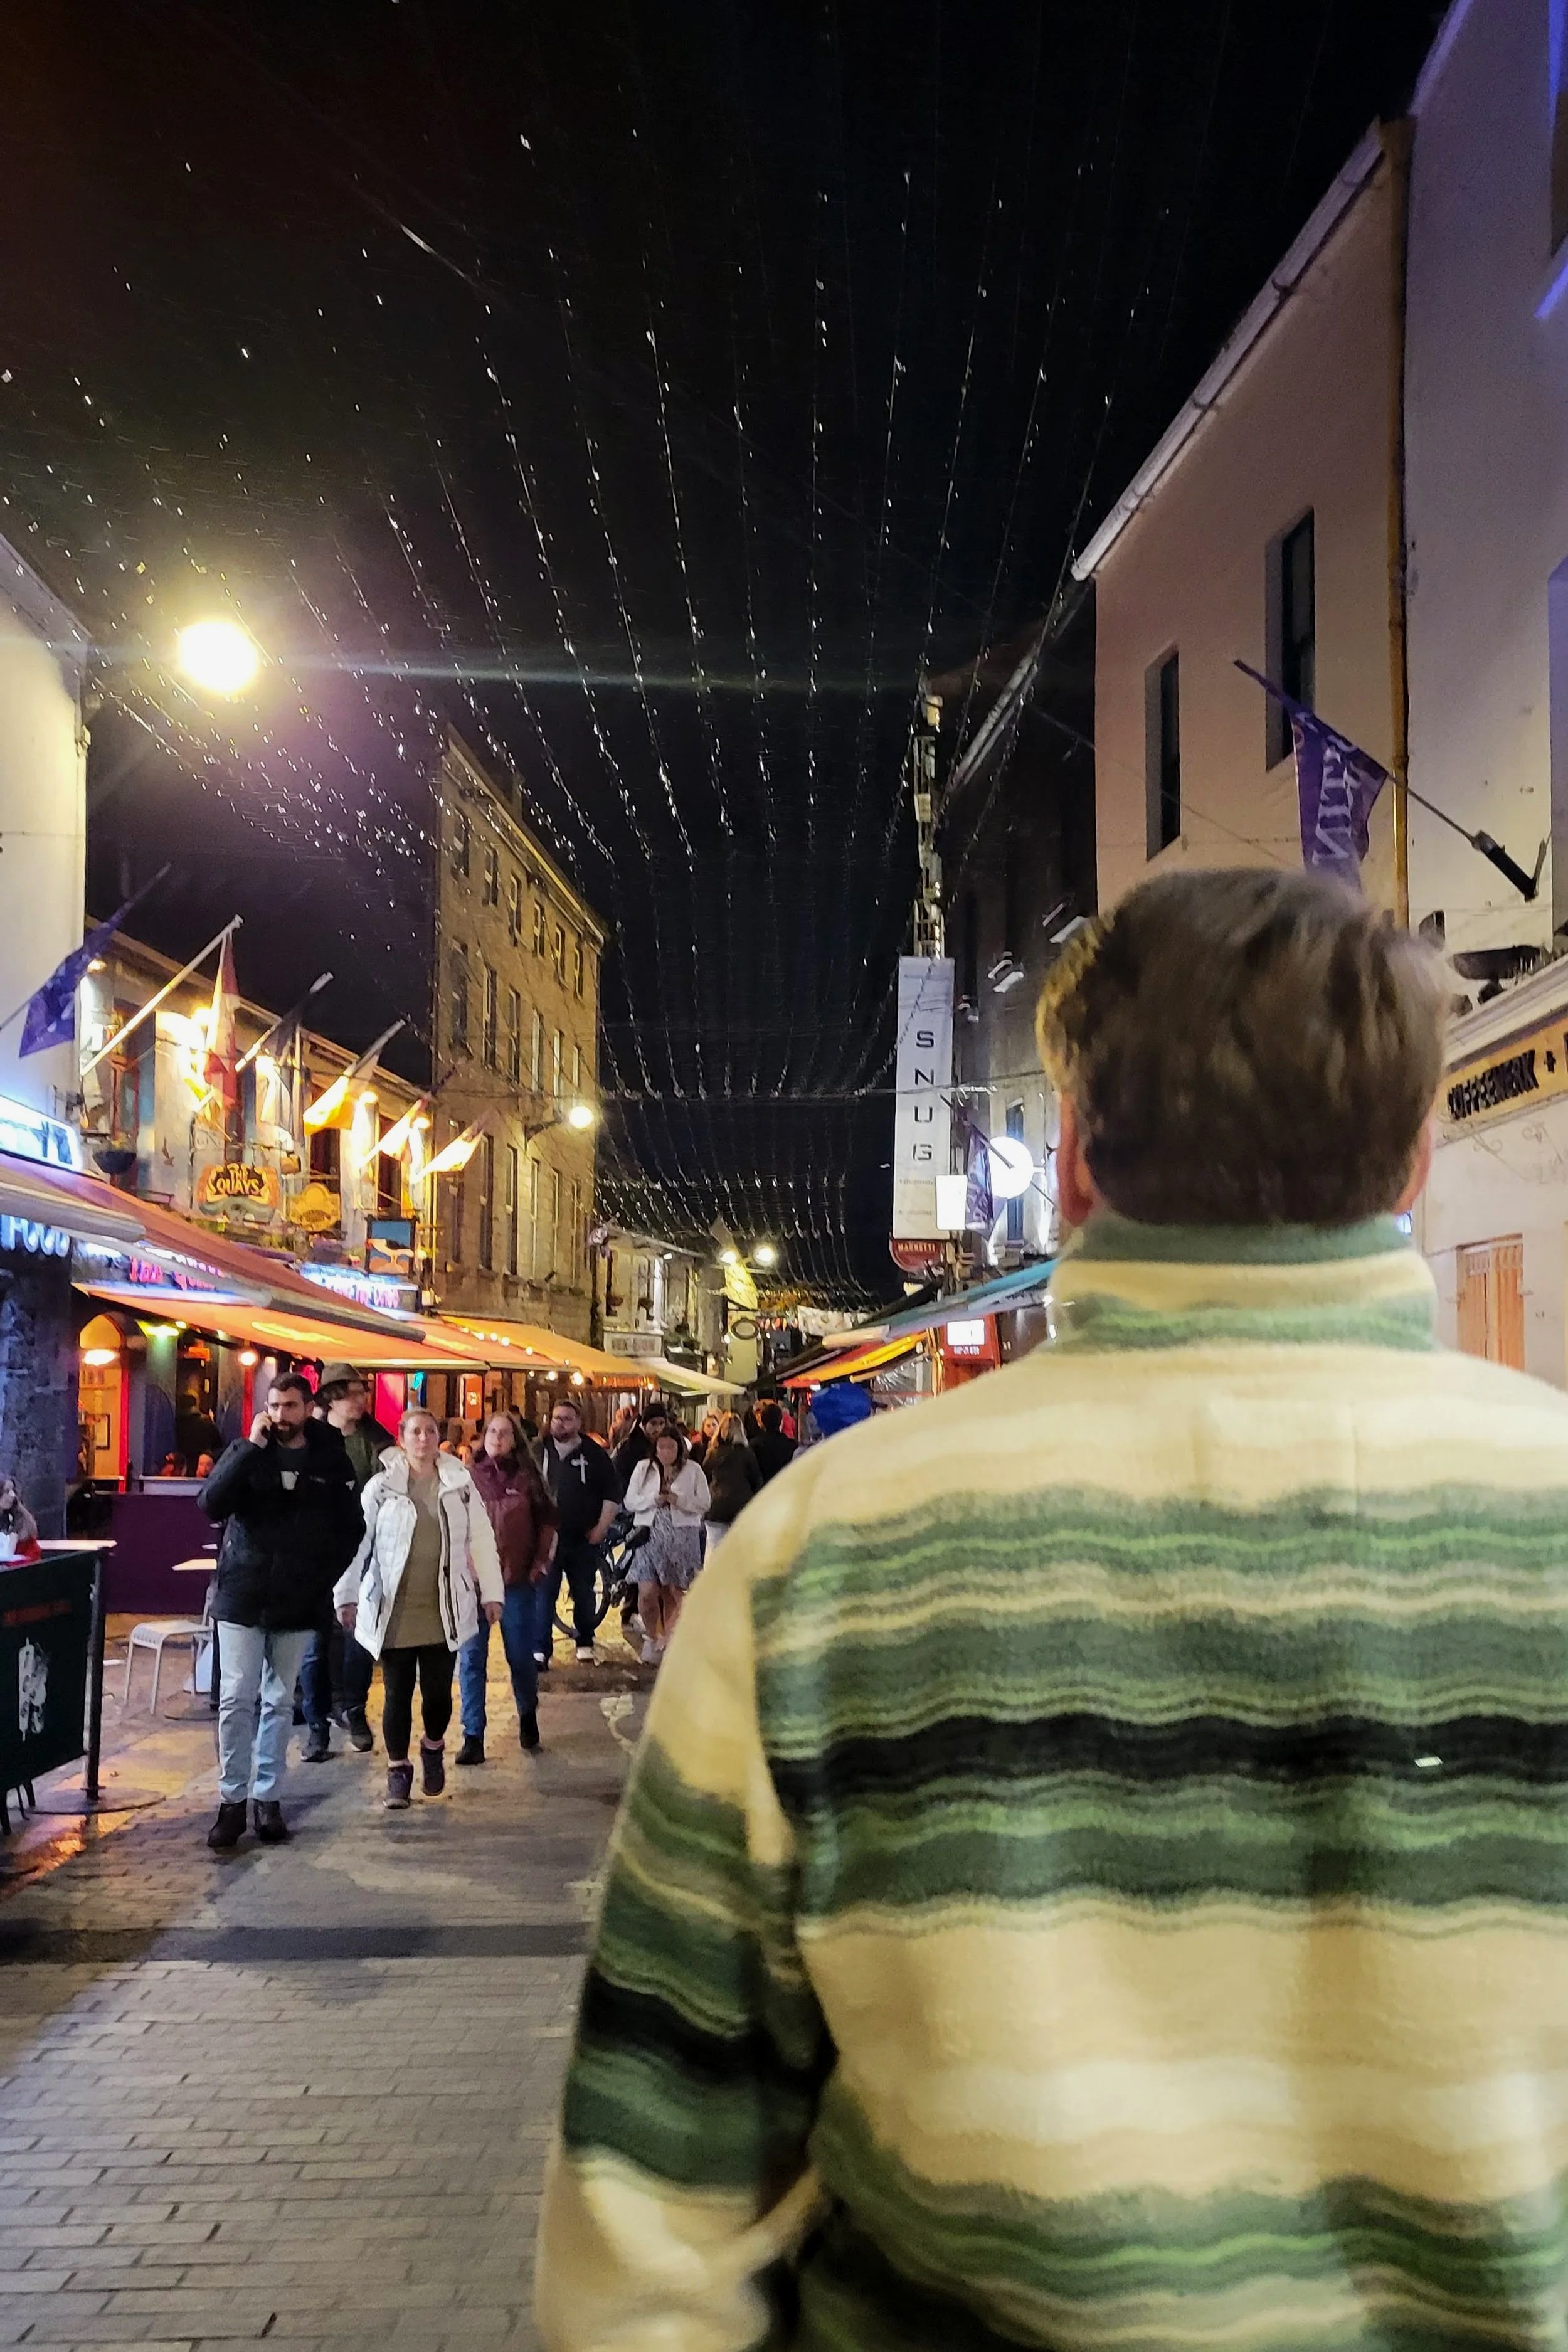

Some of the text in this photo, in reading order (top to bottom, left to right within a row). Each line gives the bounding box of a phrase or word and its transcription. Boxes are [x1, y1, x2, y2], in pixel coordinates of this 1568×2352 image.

[913, 1030, 935, 1161] SNUG
[226, 1163, 249, 1180] THE
[216, 1177, 261, 1195] QUAYS
